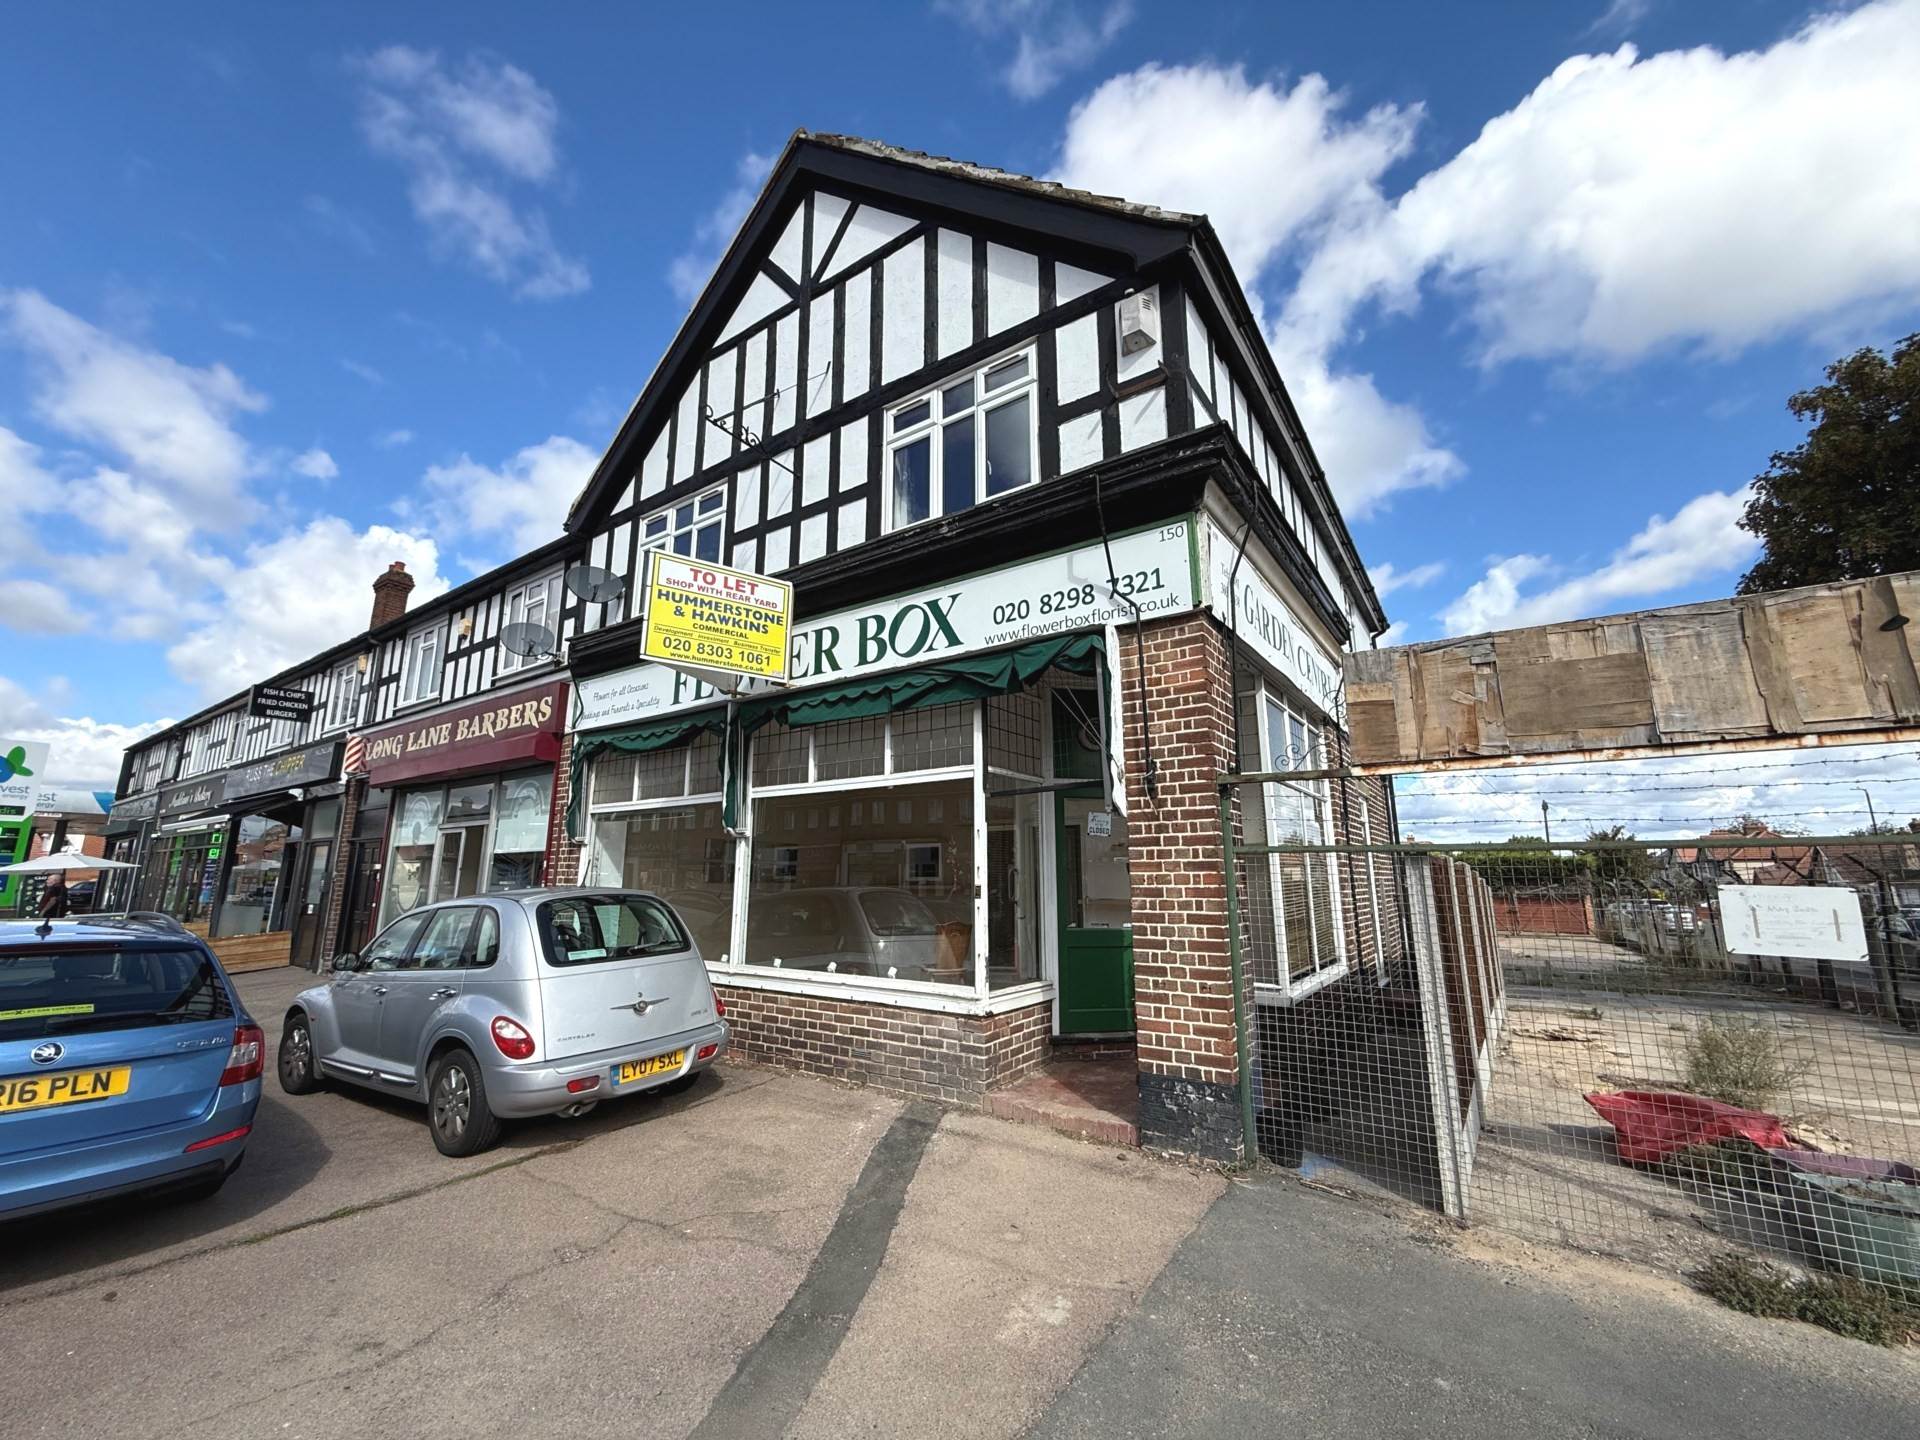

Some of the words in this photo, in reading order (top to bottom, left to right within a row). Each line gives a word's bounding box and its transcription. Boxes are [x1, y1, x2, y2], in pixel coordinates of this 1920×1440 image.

[1158, 525, 1185, 543] 150
[666, 577, 694, 590] SHOP
[697, 585, 723, 597] WITH
[726, 592, 751, 603] REAR
[754, 598, 777, 609] YARD
[690, 568, 717, 585] TO
[723, 576, 759, 595] LET
[993, 599, 1030, 625] 020
[1039, 583, 1095, 615] 8298
[1106, 567, 1165, 600] 7321
[657, 589, 784, 626] HUMMERSTONE
[673, 605, 685, 618] &
[692, 609, 769, 635] HAWKINS
[984, 592, 1181, 646] www.flowerboxfloristco.uk
[654, 625, 693, 637] Development
[692, 622, 749, 640] COMMERCIAL
[1244, 584, 1296, 668] GARDEN
[663, 636, 692, 652] 020
[696, 643, 733, 660] 8303
[738, 650, 771, 667] 1061
[670, 626, 842, 706] FLER
[854, 592, 965, 668] BOX
[670, 652, 764, 672] www.hummerstone.co.uk
[257, 698, 277, 706] FRIED
[278, 700, 308, 710] CHICKEN
[263, 688, 279, 696] FISH
[286, 691, 306, 699] CHIPS
[266, 709, 297, 719] BURGERS
[365, 734, 403, 760] LONG
[406, 722, 451, 752] LANE
[455, 696, 552, 742] BARBERS
[622, 1057, 655, 1080] LY07
[658, 1050, 681, 1070] SXL
[48, 1072, 112, 1100] PLN
